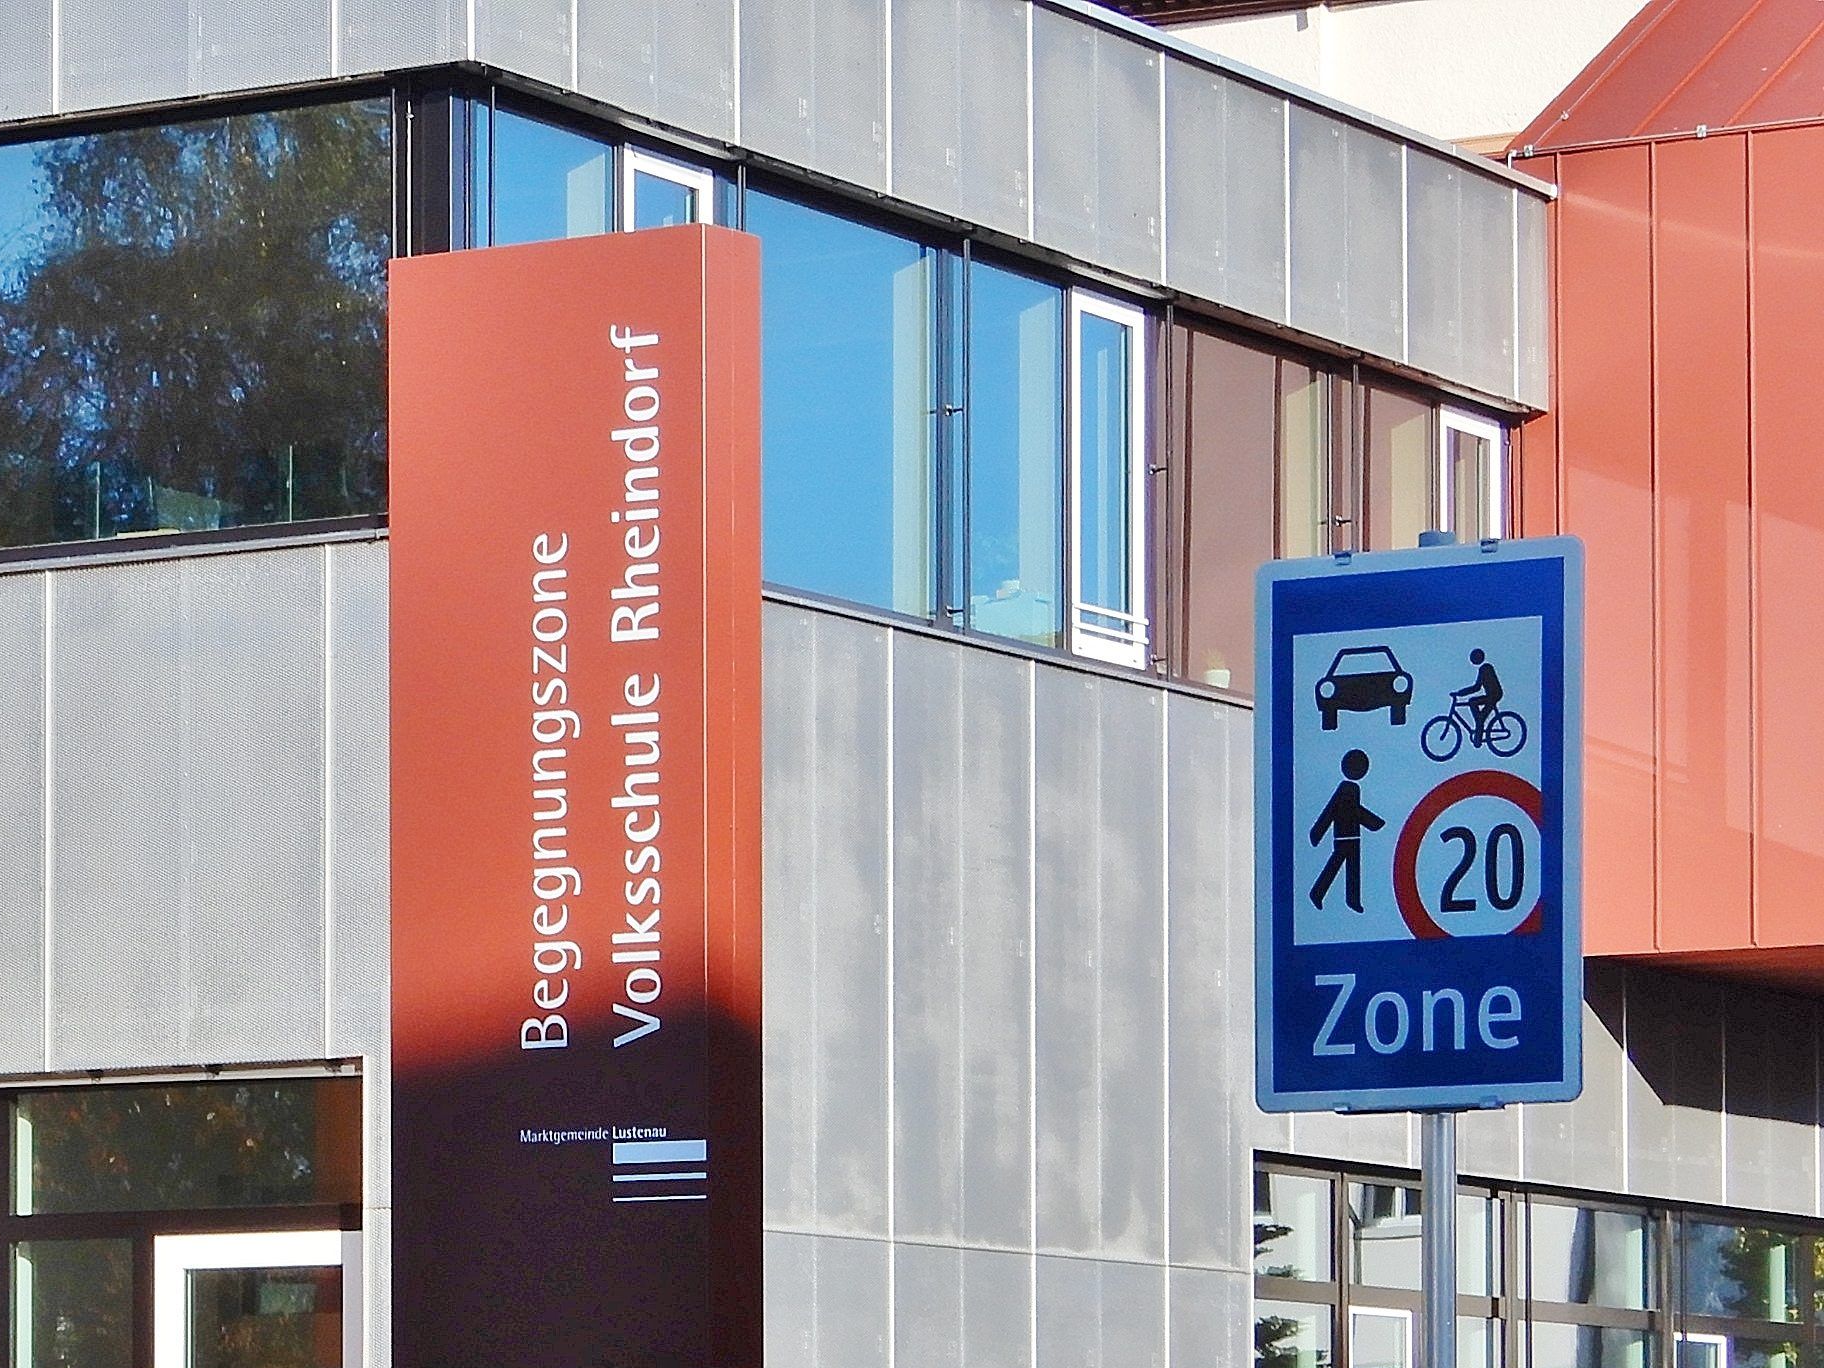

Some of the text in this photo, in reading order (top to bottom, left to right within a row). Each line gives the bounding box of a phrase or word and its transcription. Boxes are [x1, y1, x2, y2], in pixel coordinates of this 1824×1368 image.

[609, 324, 663, 1050] Volksschule Rheindorf
[520, 531, 583, 1051] Begegnungszone
[1439, 822, 1525, 914] 20
[1312, 972, 1523, 1056] Zone
[520, 1125, 668, 1145] Marktgemeinde Lustenau
